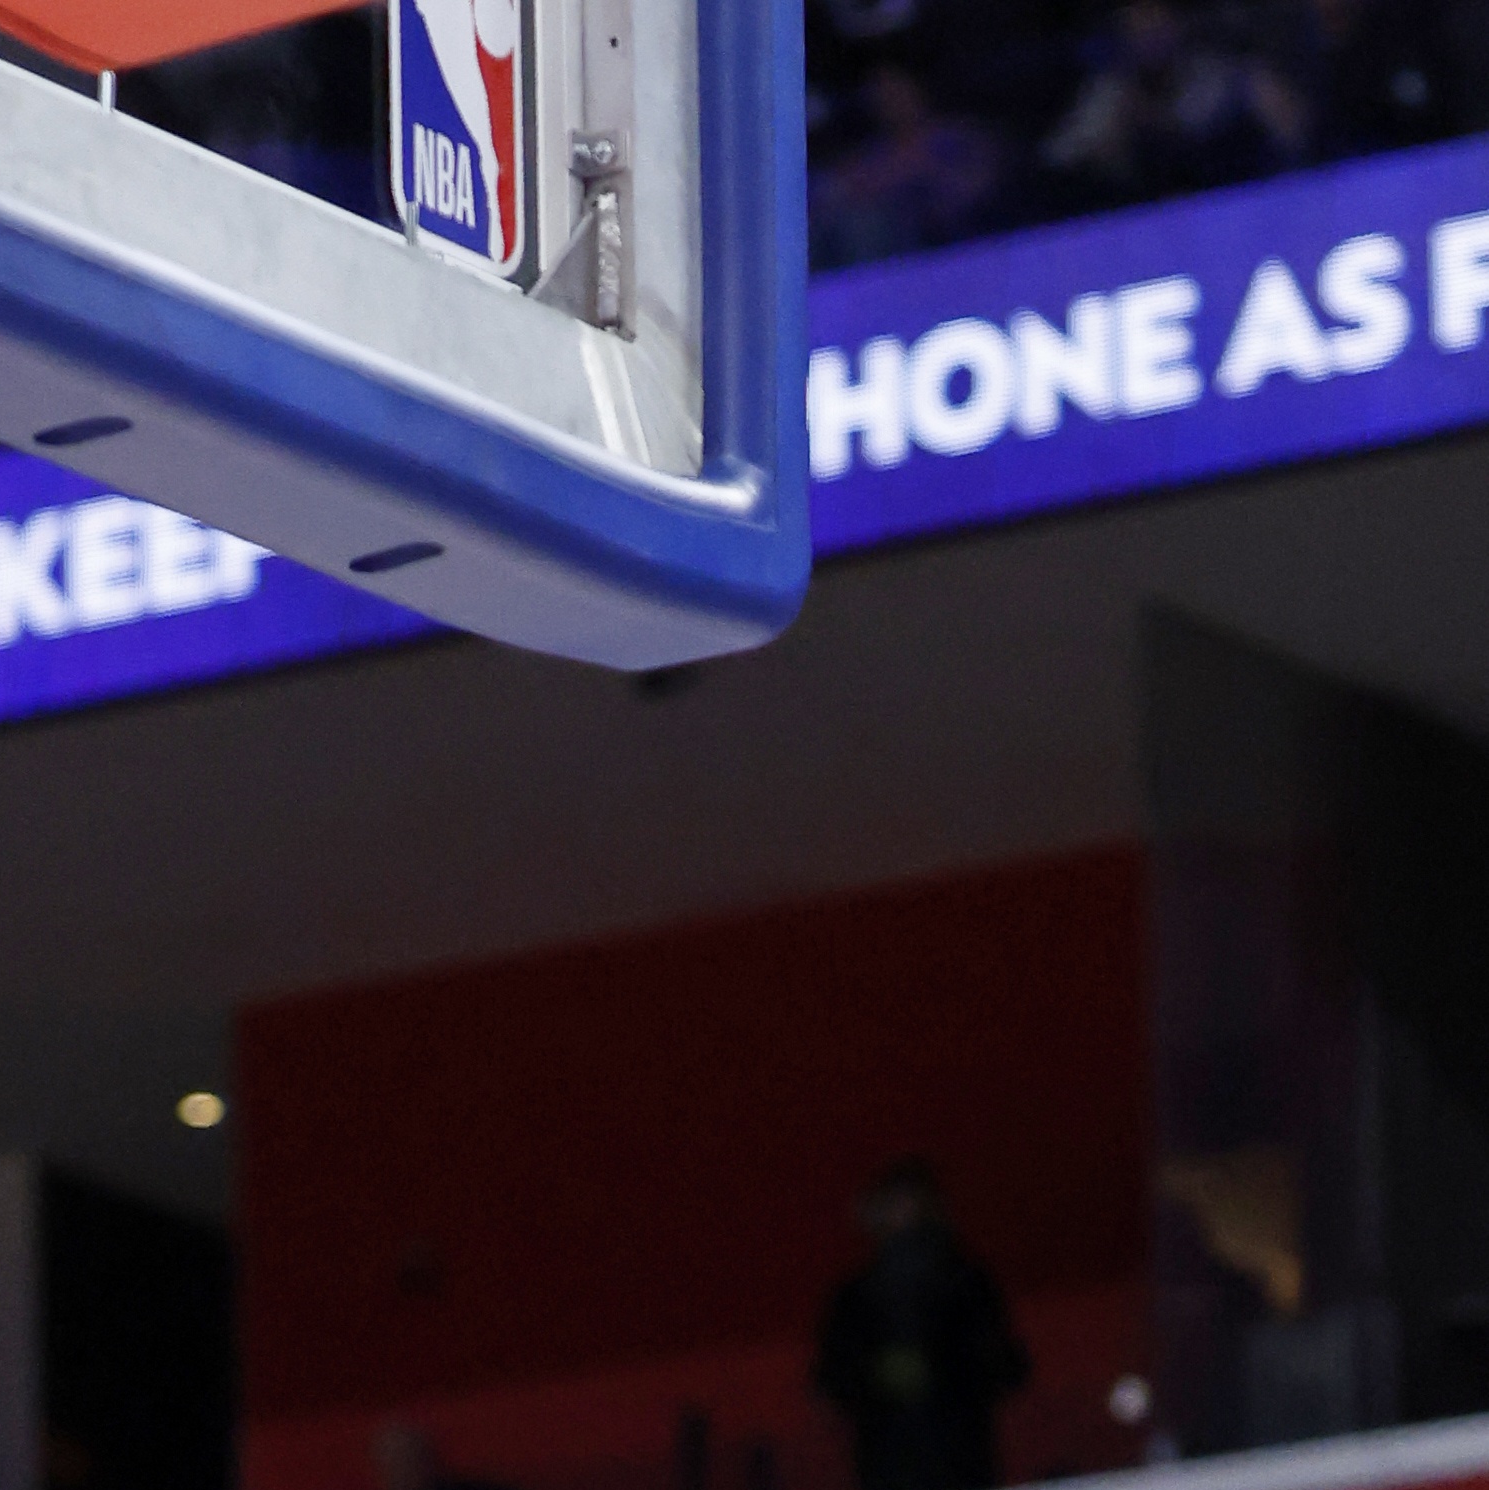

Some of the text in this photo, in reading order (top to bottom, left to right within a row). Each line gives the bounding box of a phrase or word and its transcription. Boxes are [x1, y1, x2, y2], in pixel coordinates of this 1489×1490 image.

[412, 121, 476, 229] NBA
[805, 272, 1203, 483] HONE
[1214, 230, 1413, 400] AS
